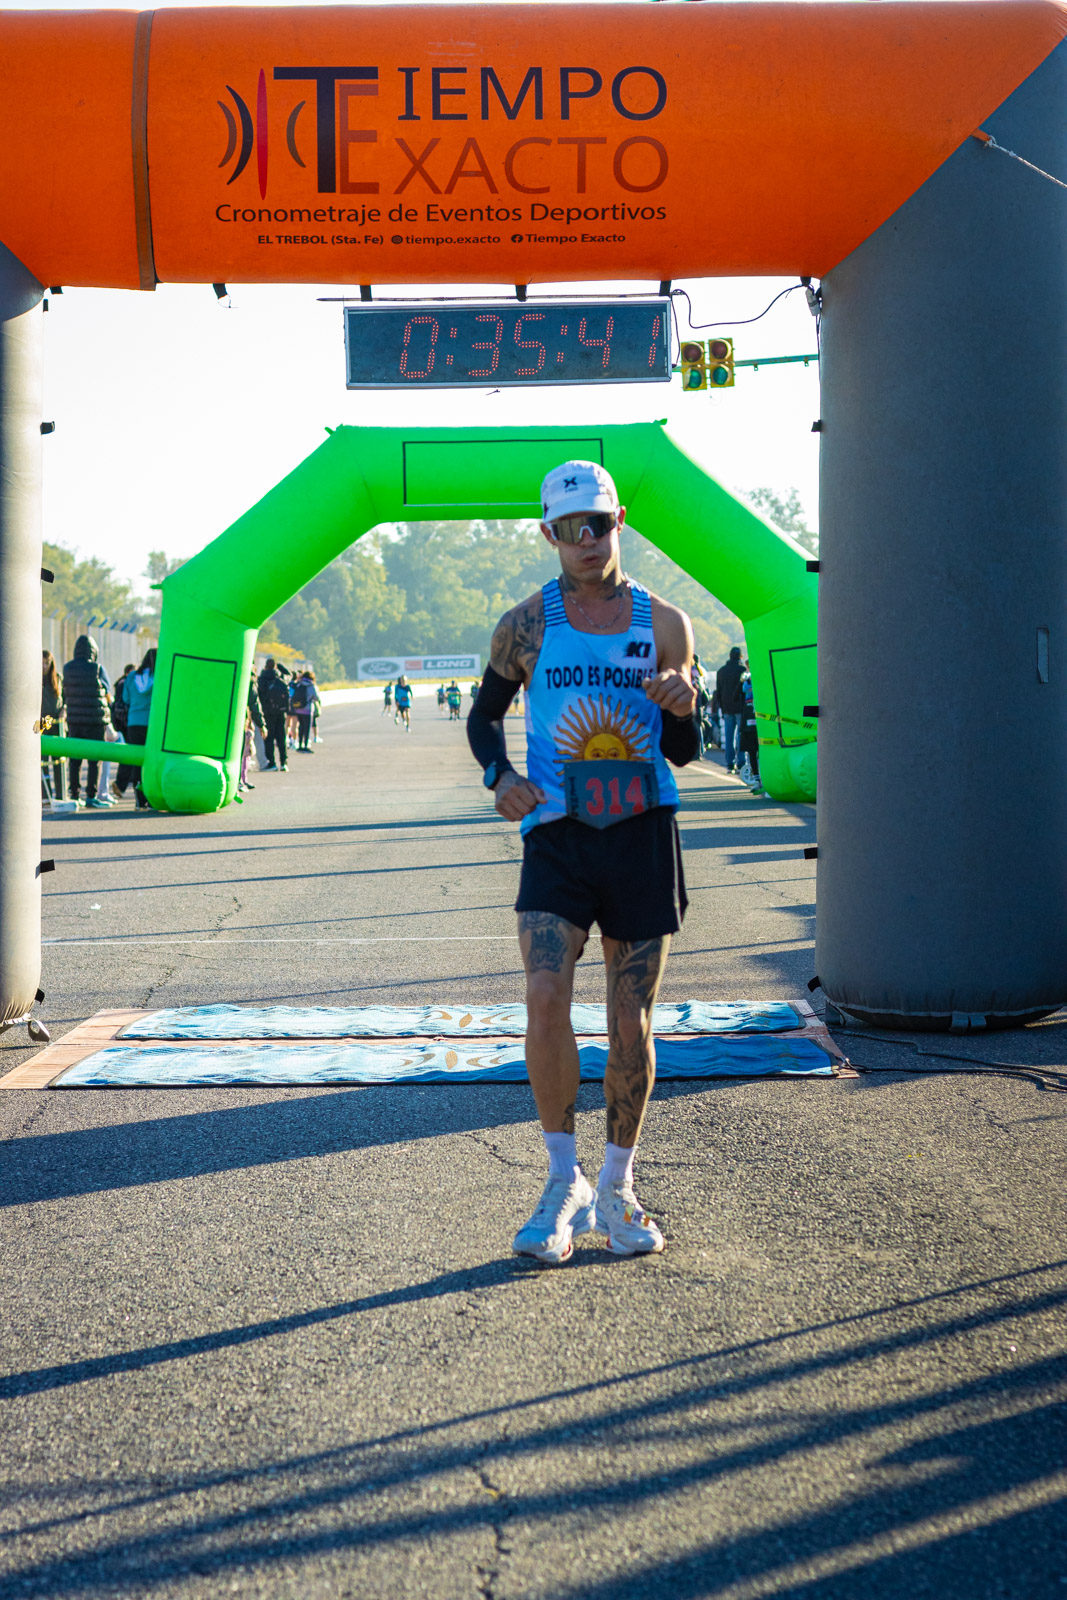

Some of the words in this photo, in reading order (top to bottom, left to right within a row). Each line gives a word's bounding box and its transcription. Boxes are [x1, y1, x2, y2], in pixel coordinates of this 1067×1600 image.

[215, 204, 381, 226] Cronometraje
[388, 203, 418, 222] de
[426, 203, 522, 222] Eventos
[530, 203, 667, 225] Deportivos
[258, 235, 273, 244] EL
[275, 235, 328, 244] TREBOL
[331, 235, 361, 245] (Sta.
[364, 235, 384, 245] Fe)
[406, 235, 501, 246] tiempo.exacto
[526, 234, 578, 244] Tiempo
[581, 234, 626, 243] Exacto
[399, 313, 661, 379] 0:35:41
[426, 660, 471, 669] LONG
[545, 665, 583, 689] TODO
[588, 665, 600, 687] ES
[586, 776, 644, 816] 314
